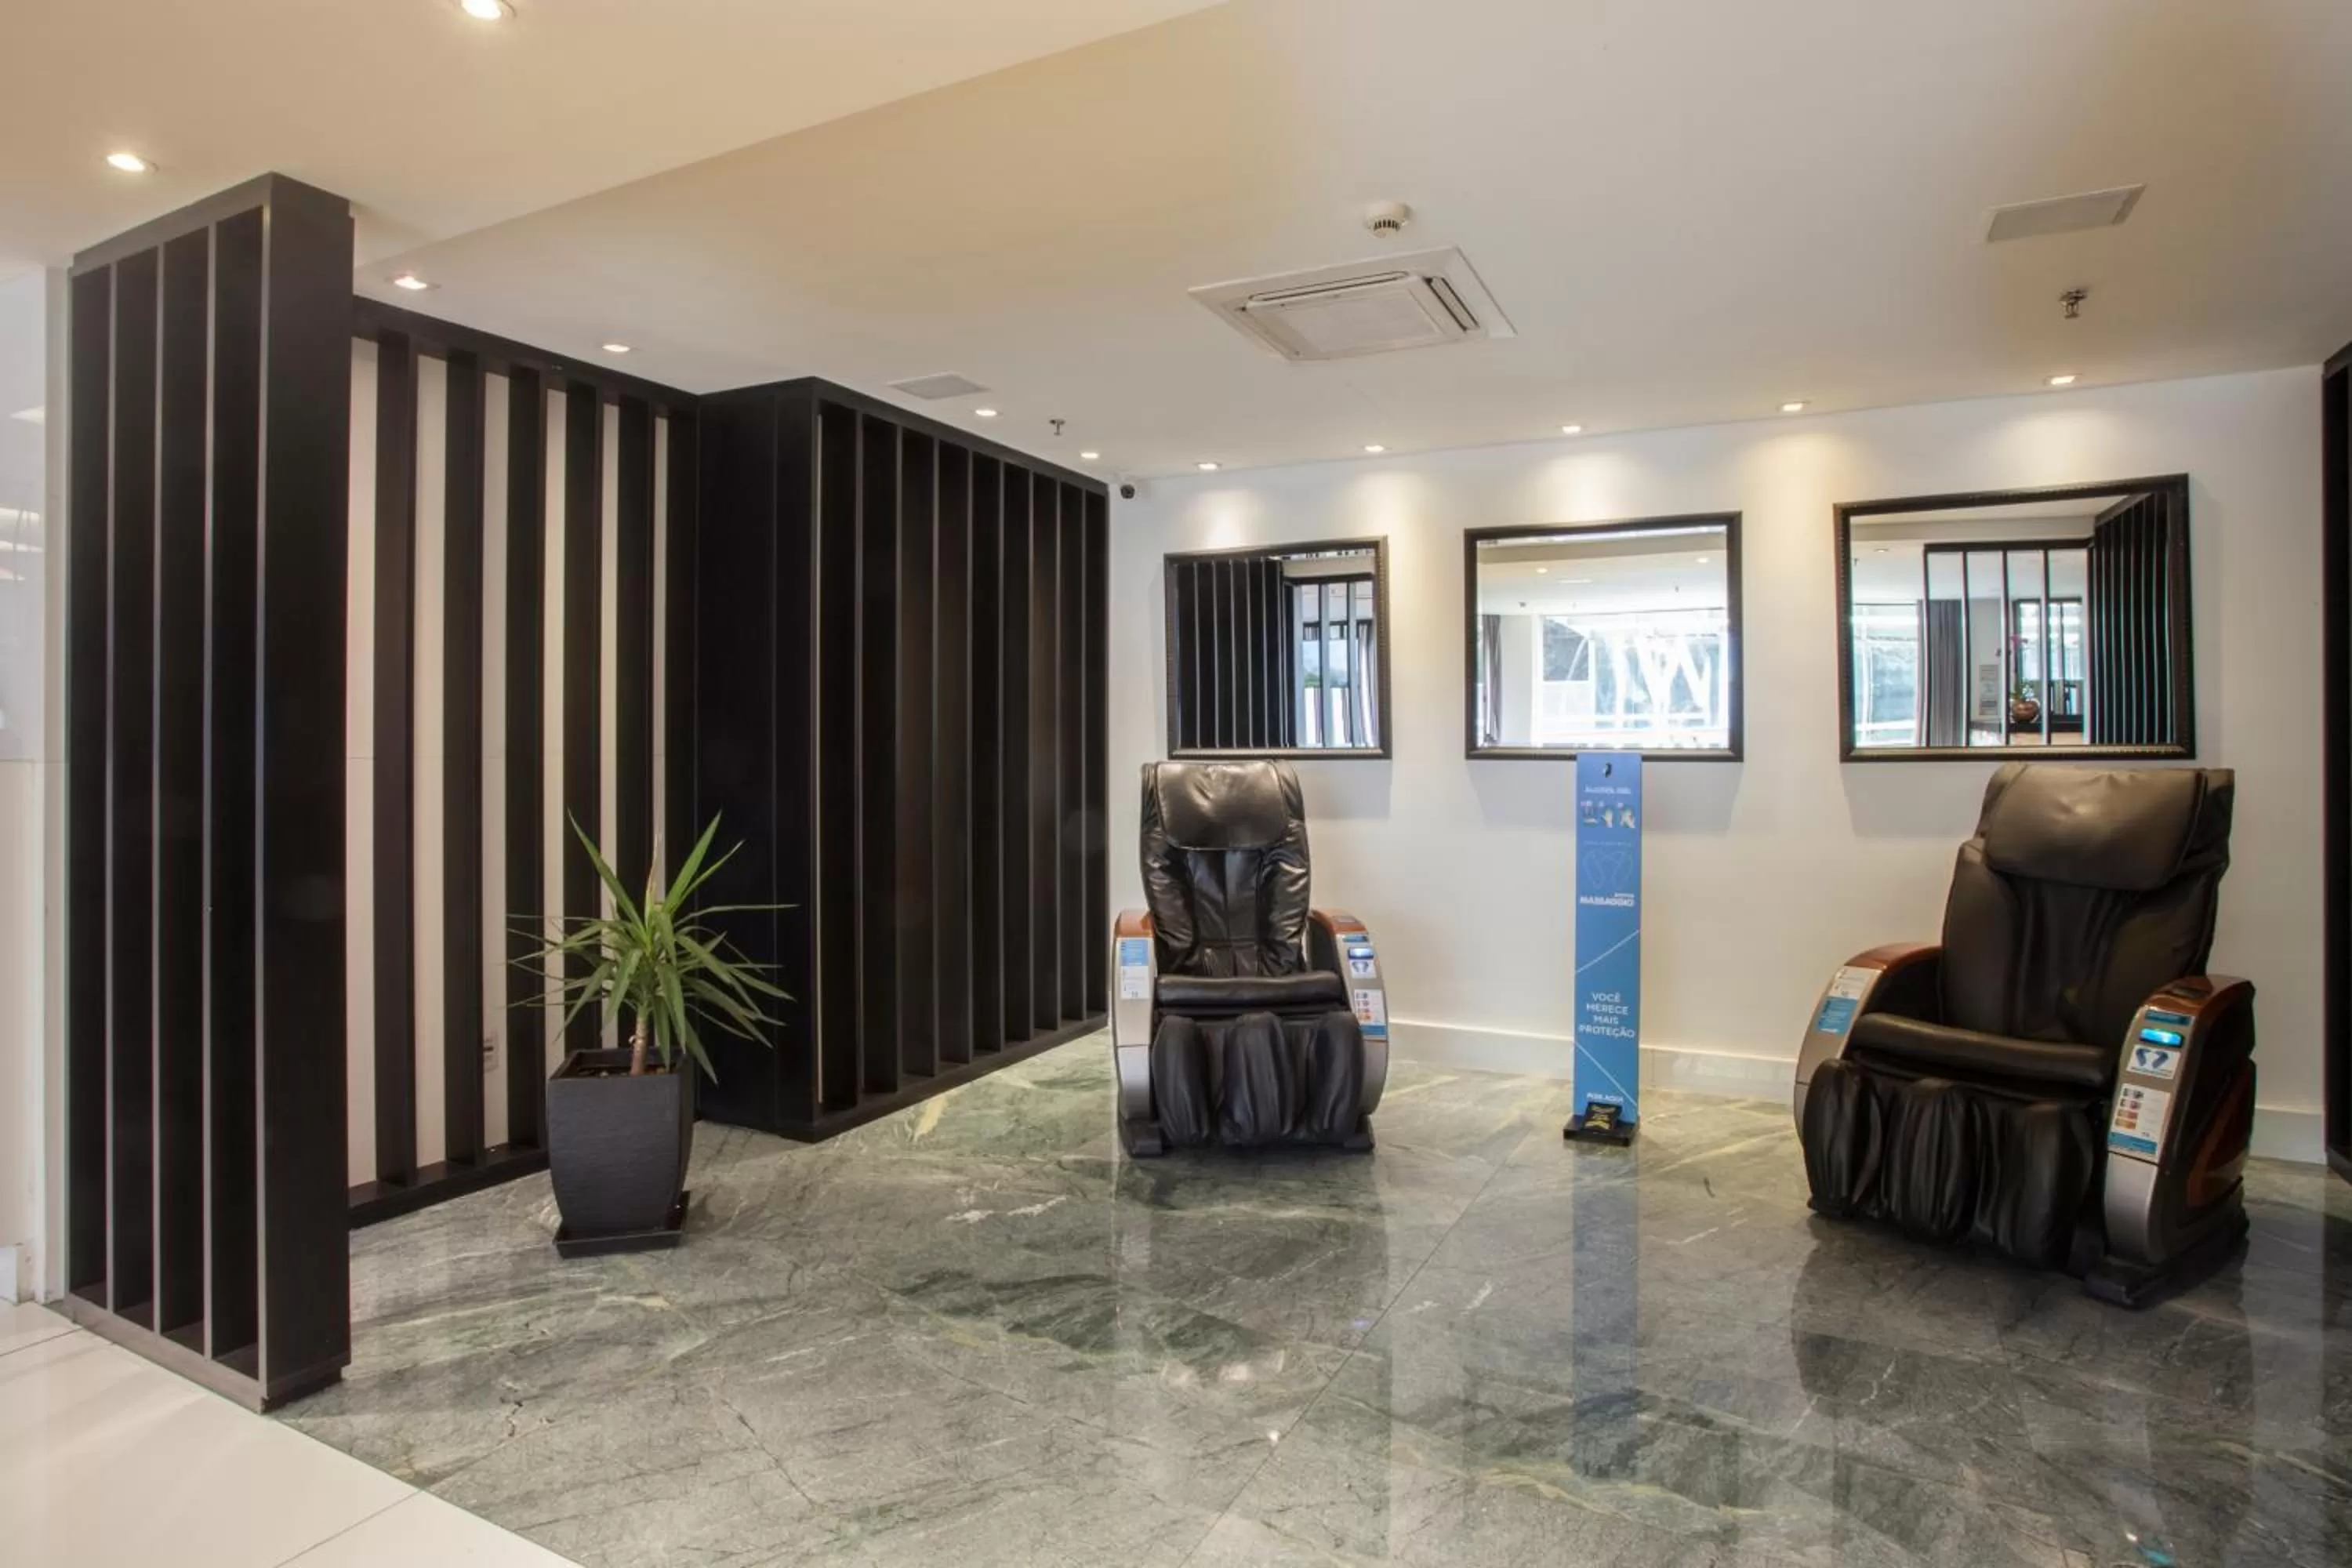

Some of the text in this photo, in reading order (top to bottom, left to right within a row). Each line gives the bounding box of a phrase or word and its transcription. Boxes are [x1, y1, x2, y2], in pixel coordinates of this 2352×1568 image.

[1592, 992, 1621, 1003] VOCÊ
[1586, 1004, 1628, 1015] MERECE
[1593, 1015, 1619, 1025] MAIS
[1579, 1025, 1635, 1039] PROTEÇÃO
